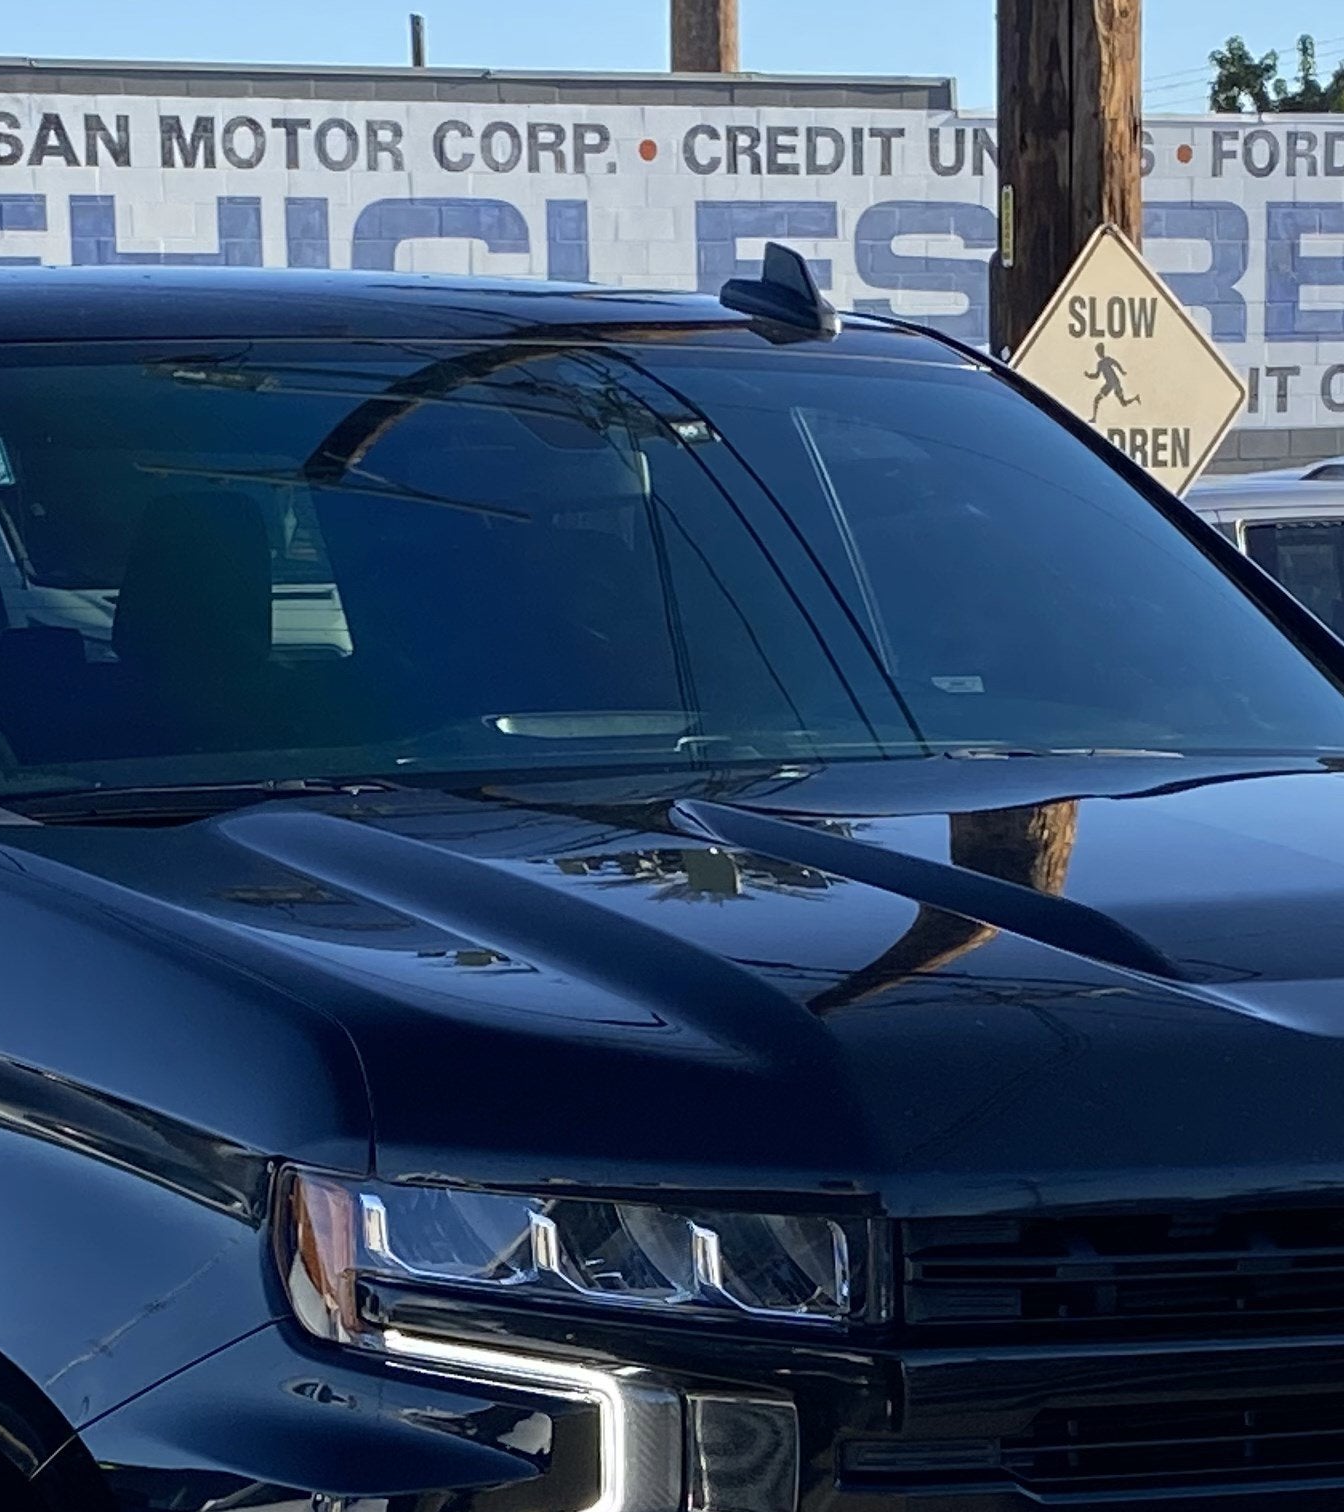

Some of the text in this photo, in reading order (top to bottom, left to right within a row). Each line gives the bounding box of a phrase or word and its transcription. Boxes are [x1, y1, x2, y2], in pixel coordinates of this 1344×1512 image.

[159, 115, 405, 171] MOTOR
[433, 120, 617, 174] CORP.
[683, 124, 905, 176] CREDIT
[1068, 297, 1158, 339] SLOW
